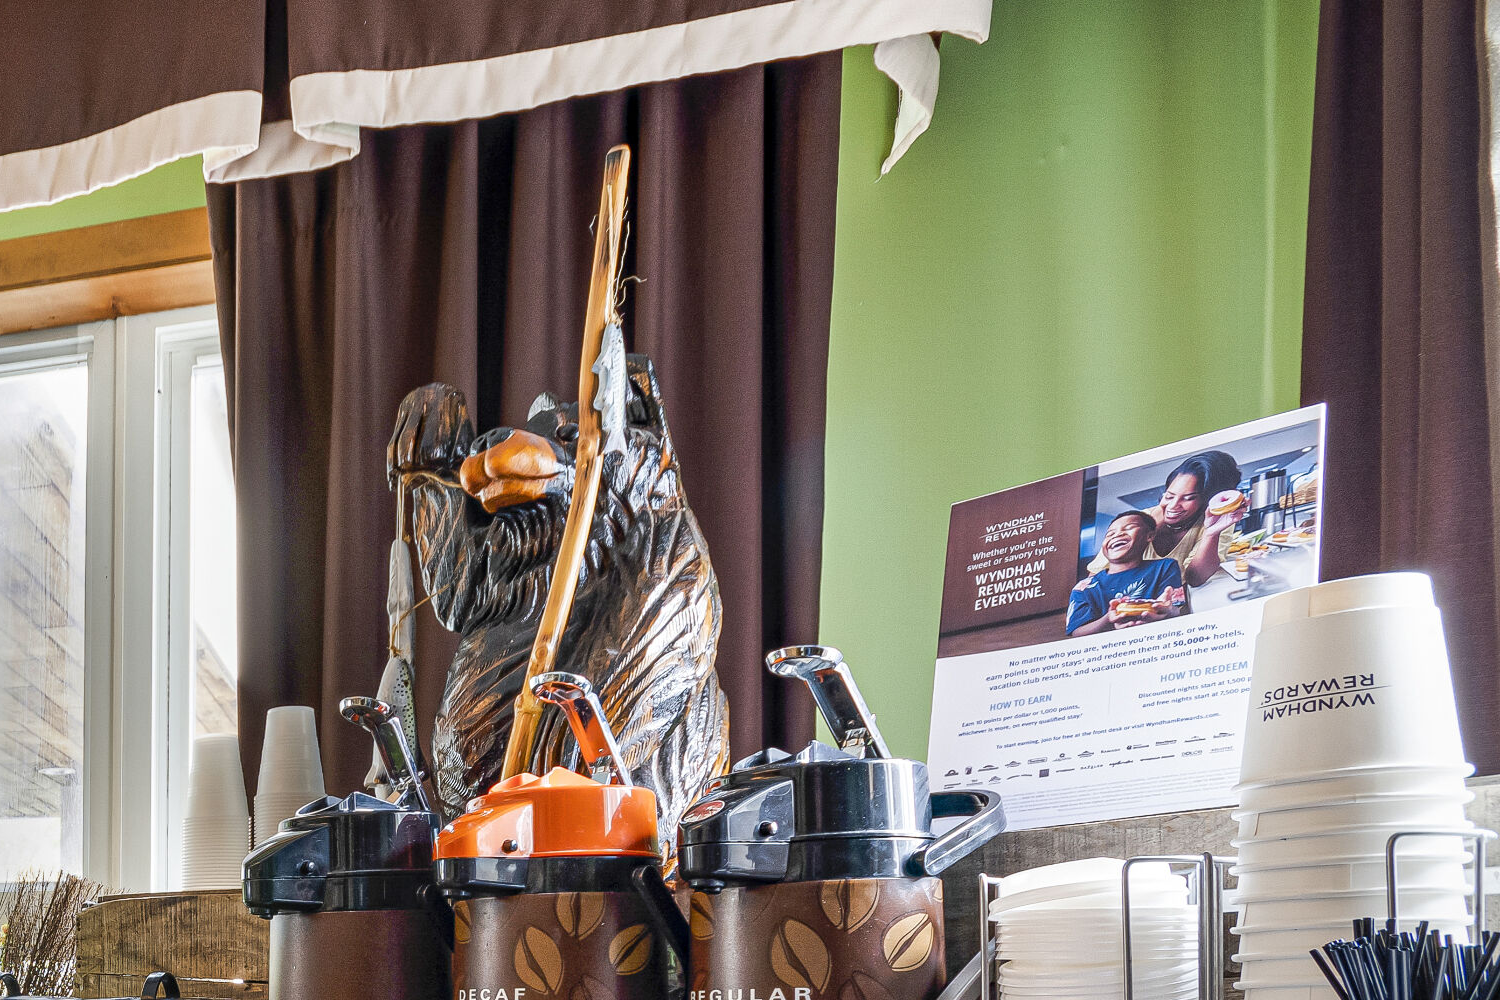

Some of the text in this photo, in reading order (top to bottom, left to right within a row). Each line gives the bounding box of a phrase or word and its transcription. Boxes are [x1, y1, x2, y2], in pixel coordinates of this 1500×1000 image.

[985, 522, 1043, 544] REWARDS
[986, 512, 1044, 533] WYNDHAM
[967, 544, 1058, 572] sweet or savory type,
[972, 536, 1053, 562] Whether you're the
[975, 560, 1046, 586] WYNDHAM
[978, 574, 1041, 598] REWARDS
[974, 586, 1046, 612] EVERYONE.
[986, 674, 1002, 682] earn
[1004, 667, 1028, 680] points
[1042, 664, 1060, 673] your
[1086, 655, 1102, 663] and
[1104, 648, 1136, 660] redeem
[1138, 644, 1160, 654] them
[1162, 642, 1171, 650] at
[1213, 630, 1245, 640] hotels,
[1009, 660, 1020, 668] No
[1022, 655, 1047, 664] matter
[1048, 652, 1065, 660] who
[1067, 650, 1082, 658] you
[1084, 646, 1099, 654] are,
[1102, 640, 1126, 650] where
[1129, 634, 1155, 646] you're
[1157, 630, 1184, 640] going,
[1198, 622, 1218, 632] why,
[989, 642, 1239, 691] vacation club resorts, and vacation rentals around the world.
[1160, 660, 1248, 682] HOW TO REDEEM
[1138, 688, 1176, 699] Discounted
[1178, 684, 1199, 693] nights
[1200, 681, 1216, 689] start
[1172, 696, 1192, 704] nights
[1194, 692, 1210, 700] start
[1263, 673, 1374, 704] REWARDS
[990, 694, 1052, 712] HOW TO EARN
[1263, 692, 1375, 722] WYNDHAM
[984, 716, 1002, 725] points
[1003, 714, 1013, 722] per
[1039, 716, 1066, 724] qualified
